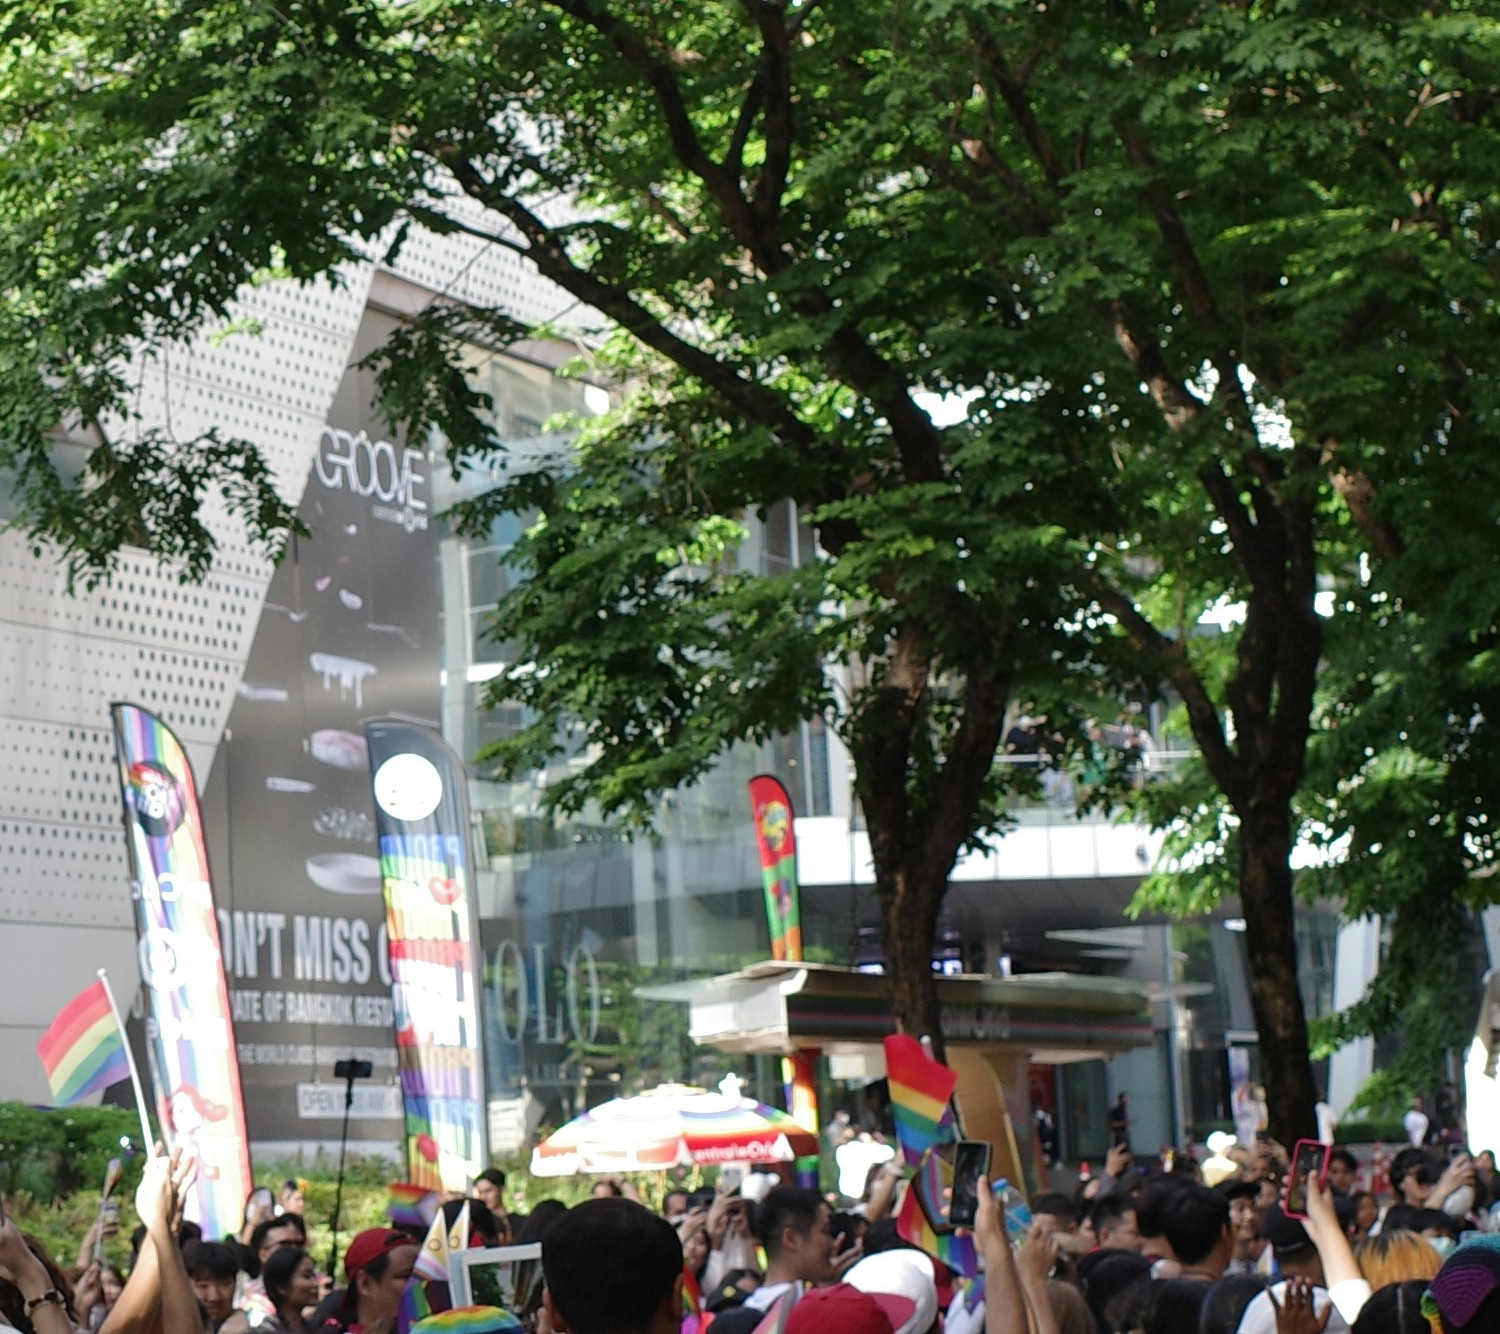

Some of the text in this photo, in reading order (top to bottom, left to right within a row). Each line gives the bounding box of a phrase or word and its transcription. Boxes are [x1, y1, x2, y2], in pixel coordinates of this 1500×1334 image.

[315, 425, 428, 510] GROOVE
[293, 915, 371, 984] MISS
[263, 992, 284, 1022] OF
[483, 938, 600, 1045] OLO
